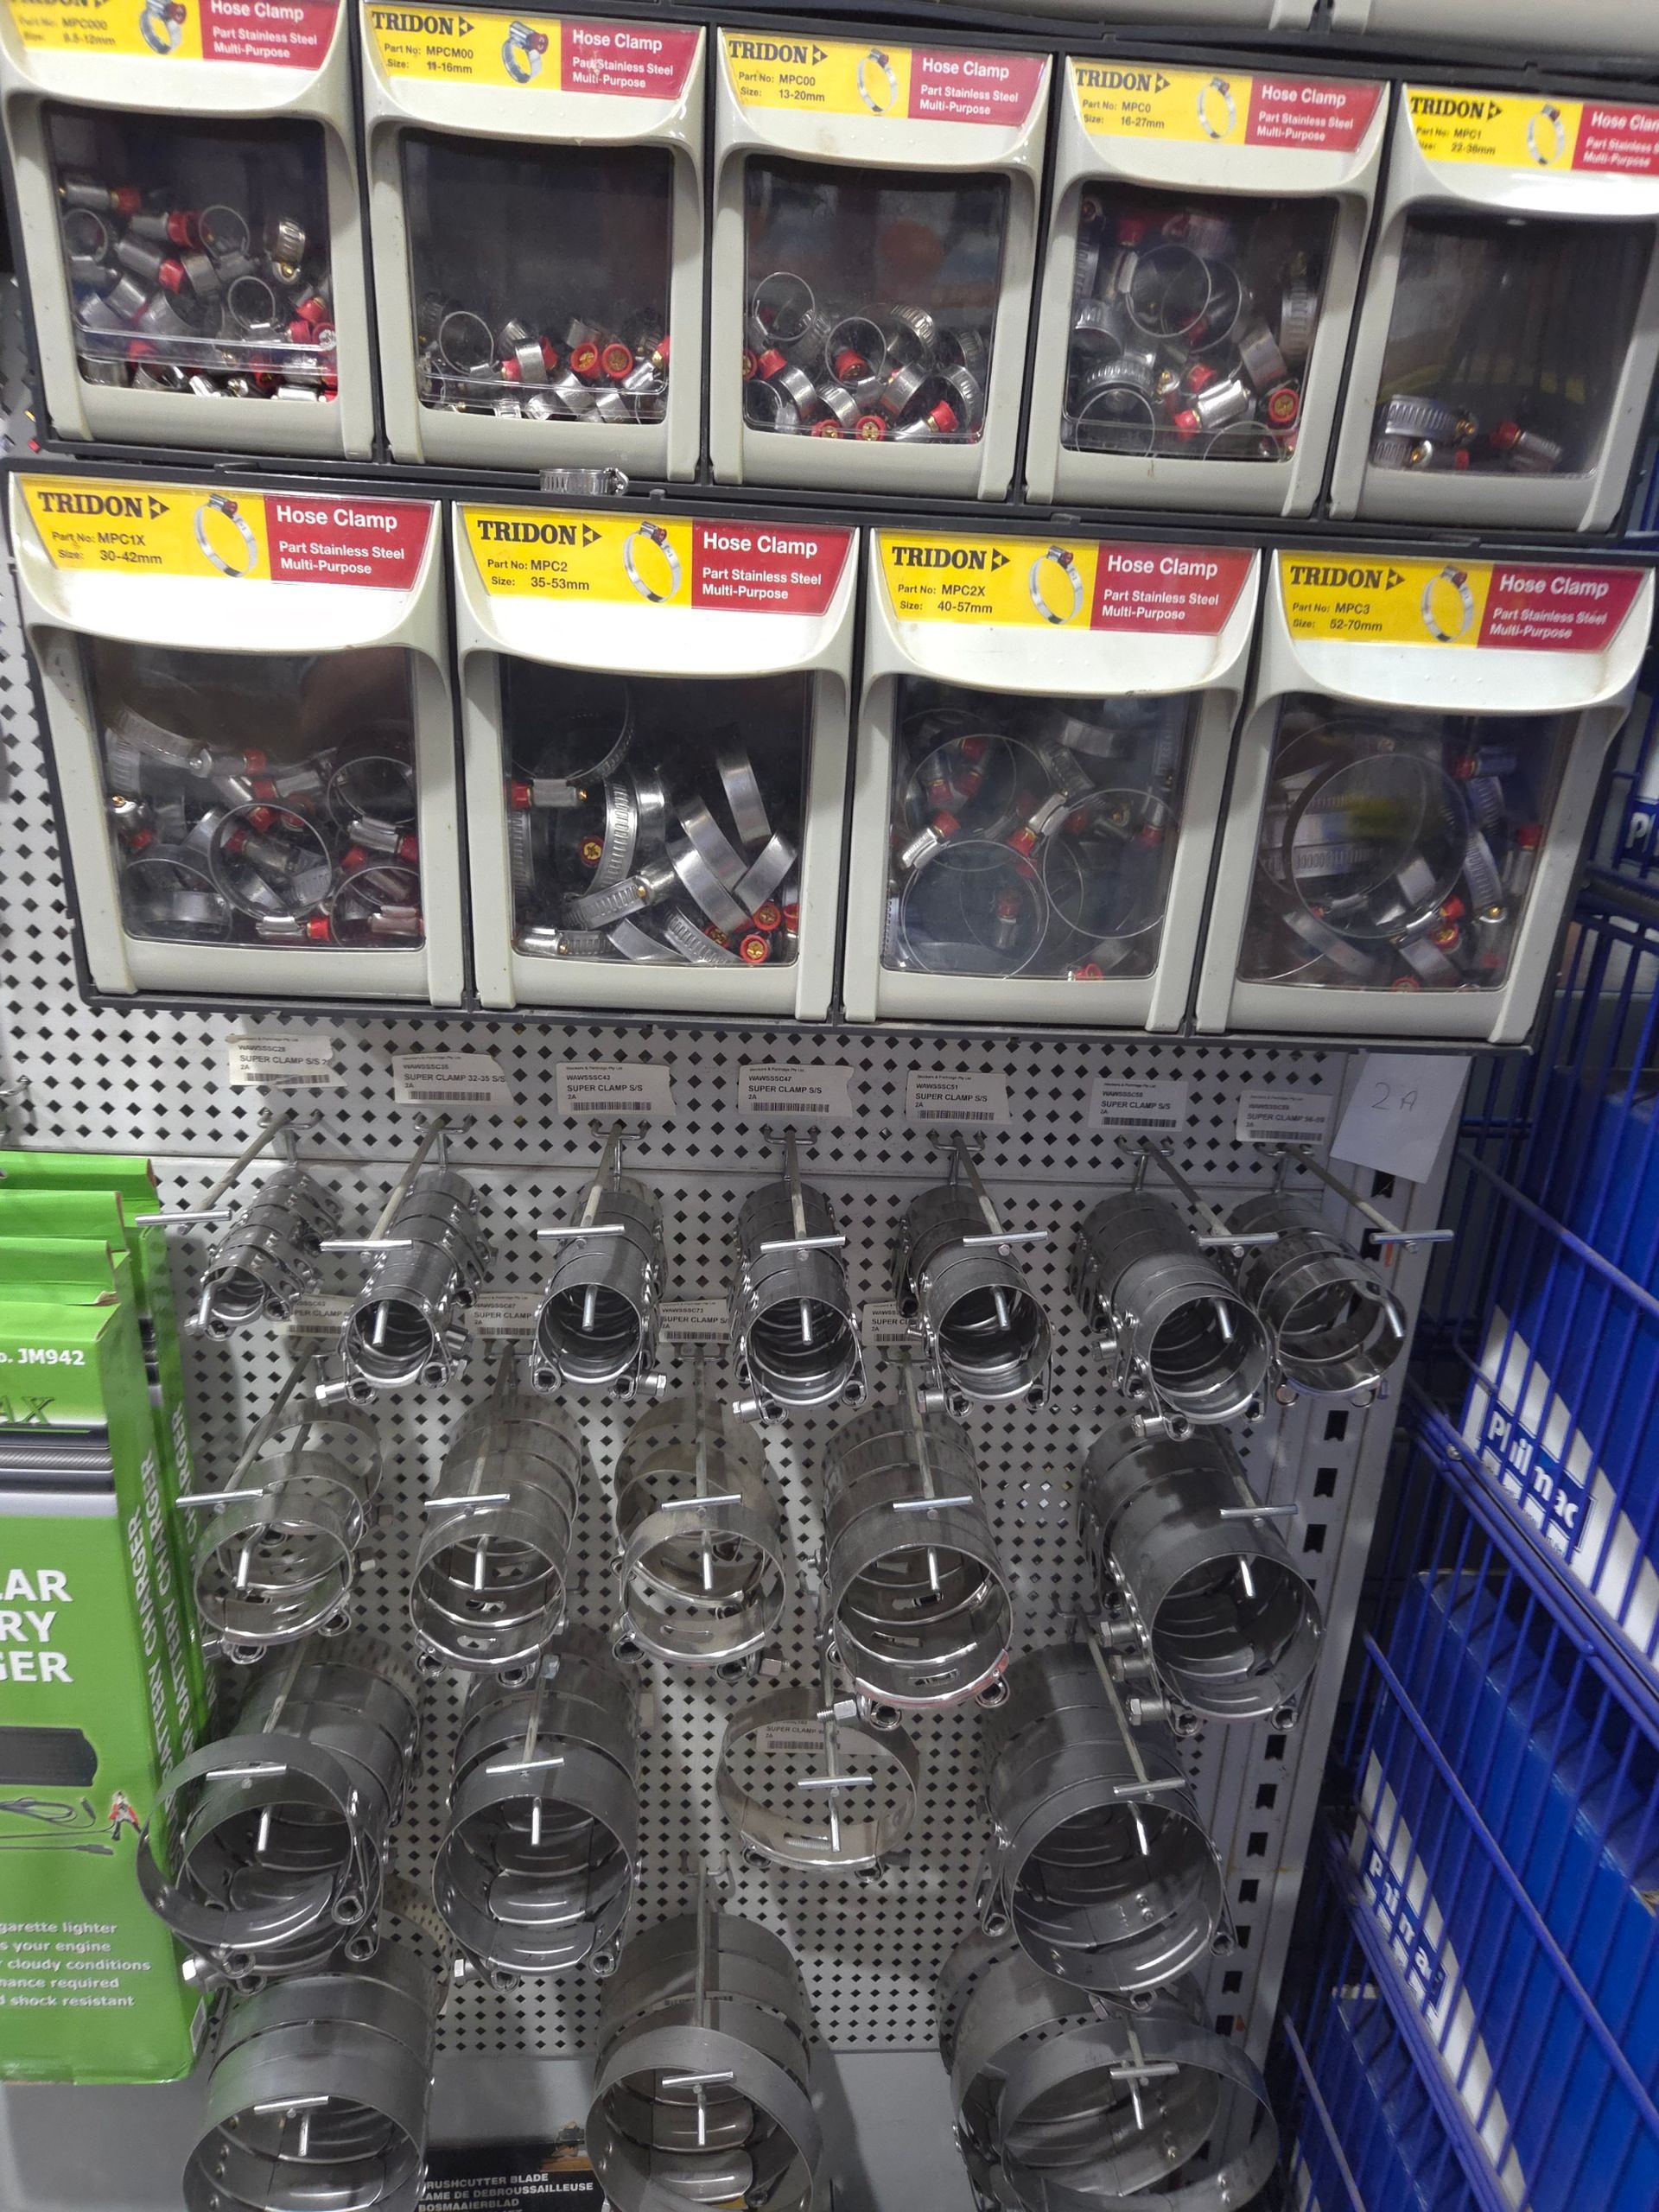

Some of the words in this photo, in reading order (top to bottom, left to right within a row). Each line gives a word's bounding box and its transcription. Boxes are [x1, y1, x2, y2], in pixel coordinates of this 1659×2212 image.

[211, 0, 250, 16] Hose
[255, 3, 304, 23] Clamp
[372, 11, 454, 35] TRIDON
[213, 27, 235, 39] Part
[238, 29, 287, 42] Stainless
[290, 33, 317, 45] Steel
[573, 29, 610, 46] Hose
[614, 33, 662, 54] Clamp
[213, 41, 290, 59] Multi-Purpose
[385, 43, 403, 53] Part
[406, 45, 421, 54] No:
[426, 46, 474, 59] MPCM00
[728, 40, 808, 64] TRIDON
[387, 59, 409, 68] Size:
[427, 61, 472, 73] 11-16mm
[598, 59, 644, 73] Stainless
[646, 63, 673, 76] Steel
[923, 57, 959, 74] Hose
[963, 60, 1009, 80] Clamp
[573, 72, 645, 88] Multi-Purpose
[739, 72, 757, 81] Part
[760, 73, 773, 83] No:
[779, 74, 815, 86] MPC00
[1076, 69, 1152, 92] TRIDON
[741, 86, 761, 97] Size:
[779, 89, 825, 102] 13-20mm
[921, 85, 942, 96] Part
[944, 86, 989, 100] Stainless
[993, 91, 1019, 103] Steel
[1262, 85, 1297, 102] Hose
[1301, 88, 1346, 108] Clamp
[920, 99, 991, 115] Multi-Purpose
[1083, 99, 1100, 109] Part
[1103, 101, 1117, 111] No:
[1122, 102, 1151, 112] MPC0
[1411, 97, 1484, 119] TRIDON
[1084, 115, 1103, 124] Size:
[1121, 117, 1164, 128] 16-27mm
[1259, 111, 1279, 122] Part
[1282, 112, 1325, 126] Stainless
[1328, 117, 1353, 130] Steel
[1591, 111, 1627, 130] Hose
[1257, 126, 1325, 142] Multi-Purpose
[1586, 136, 1607, 149] Part
[1608, 138, 1652, 154] Stainless
[1583, 150, 1651, 167] Multi-Purpose
[37, 492, 143, 518] TRIDON
[276, 505, 327, 524] Hose
[334, 509, 397, 532] Clamp
[52, 532, 75, 542] Part
[77, 533, 95, 543] No:
[98, 532, 145, 546] MPC1X
[478, 520, 577, 545] TRIDON
[279, 541, 307, 554] Part
[310, 543, 369, 557] Stainless
[372, 547, 404, 559] Steel
[703, 531, 752, 551] Hose
[757, 536, 817, 559] Clamp
[59, 550, 83, 560] Size:
[100, 550, 162, 564] 30-42mm
[487, 559, 508, 569] Part
[511, 560, 527, 569] No:
[531, 560, 568, 572] MPC2
[892, 546, 987, 569] TRIDON
[281, 558, 372, 575] Multi-Purpose
[1108, 555, 1154, 573] Hose
[1160, 557, 1217, 580] Clamp
[492, 576, 515, 586] Size:
[531, 577, 589, 591] 35-53mm
[702, 567, 728, 579] Part
[732, 569, 787, 582] Stainless
[791, 573, 821, 585] Steel
[1290, 565, 1382, 590] TRIDON
[702, 584, 788, 601] Multi-Purpose
[898, 584, 918, 594] Part
[920, 585, 936, 594] No:
[942, 584, 985, 596] MPC2X
[1499, 574, 1546, 594] Hose
[1551, 576, 1610, 600] Clamp
[1103, 589, 1129, 601] Part
[1132, 590, 1185, 603] Stainless
[1189, 593, 1218, 605] Steel
[900, 601, 923, 610] Size:
[938, 601, 993, 613] 40-57mm
[1103, 605, 1185, 620] Multi-Purpose
[1293, 602, 1312, 612] Part
[1313, 603, 1330, 613] No:
[1335, 602, 1370, 615] MPC3
[1493, 607, 1518, 620] Part
[1521, 608, 1574, 623] Stainless
[1576, 611, 1607, 625] Steel
[1294, 619, 1314, 628] Size:
[1330, 620, 1382, 632] 52-70mm
[1490, 624, 1573, 639] Multi-Purpose
[18, 1348, 85, 1365] JM942
[141, 1449, 170, 1596] CHARGER
[128, 1505, 158, 1656] CHARGER
[63, 1922, 118, 1936] lighter
[13, 1942, 50, 1952] your
[56, 1941, 111, 1954] engine
[8, 1958, 61, 1972] cloudy
[66, 1959, 151, 1971] conditions
[51, 1977, 119, 1990] required
[10, 1995, 57, 2006] shock
[62, 1995, 135, 2006] resistant
[511, 2173, 549, 2183] BLADE
